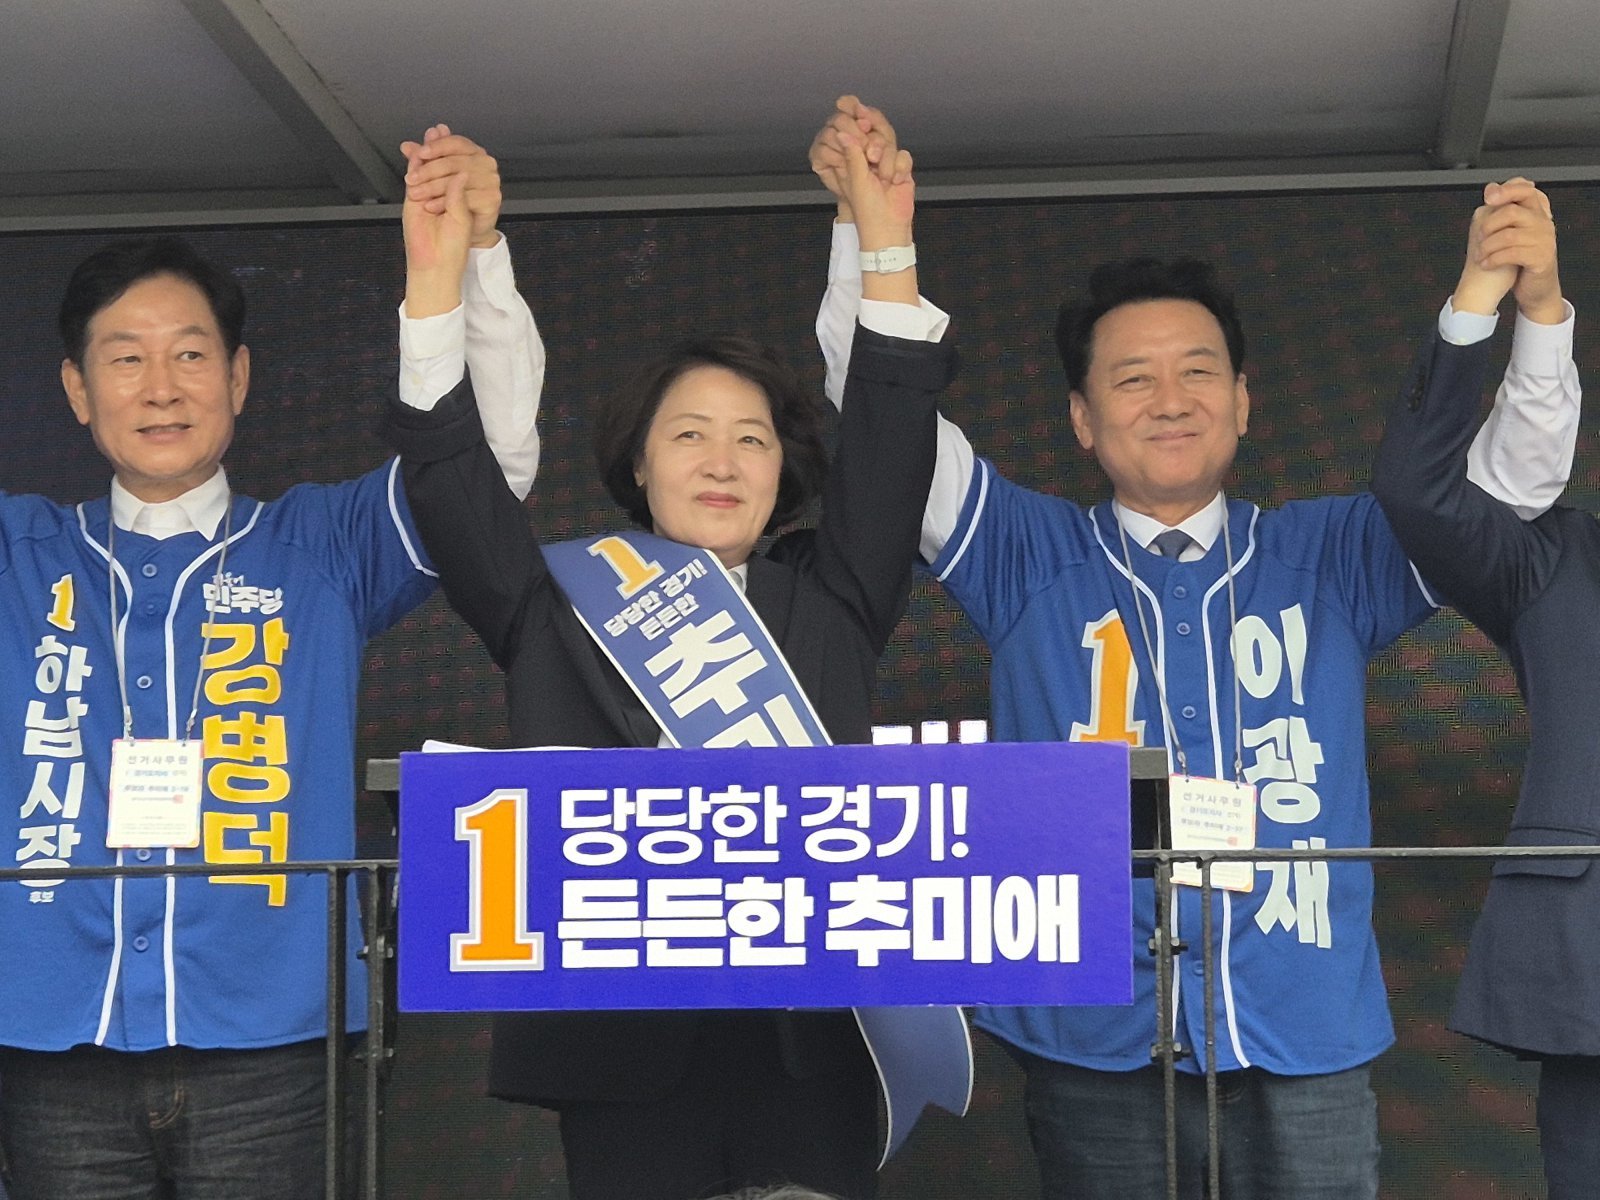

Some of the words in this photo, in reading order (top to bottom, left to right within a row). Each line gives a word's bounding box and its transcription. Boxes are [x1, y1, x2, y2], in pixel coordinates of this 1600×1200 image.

[47, 573, 75, 631] 1
[203, 583, 283, 615] 민주당
[586, 536, 666, 600] 1
[603, 590, 663, 637] 당당한
[659, 558, 708, 597] 경기!
[638, 592, 700, 641] 든든한
[1069, 608, 1147, 747] 1
[15, 635, 93, 887] 하남시장
[201, 617, 291, 907] 강병덕
[1230, 602, 1332, 949] 이광재
[560, 784, 787, 865] 당당한
[800, 782, 970, 862] 경기!
[450, 788, 545, 971] 1
[558, 876, 814, 968] 든든한
[825, 874, 1080, 967] 추미애
